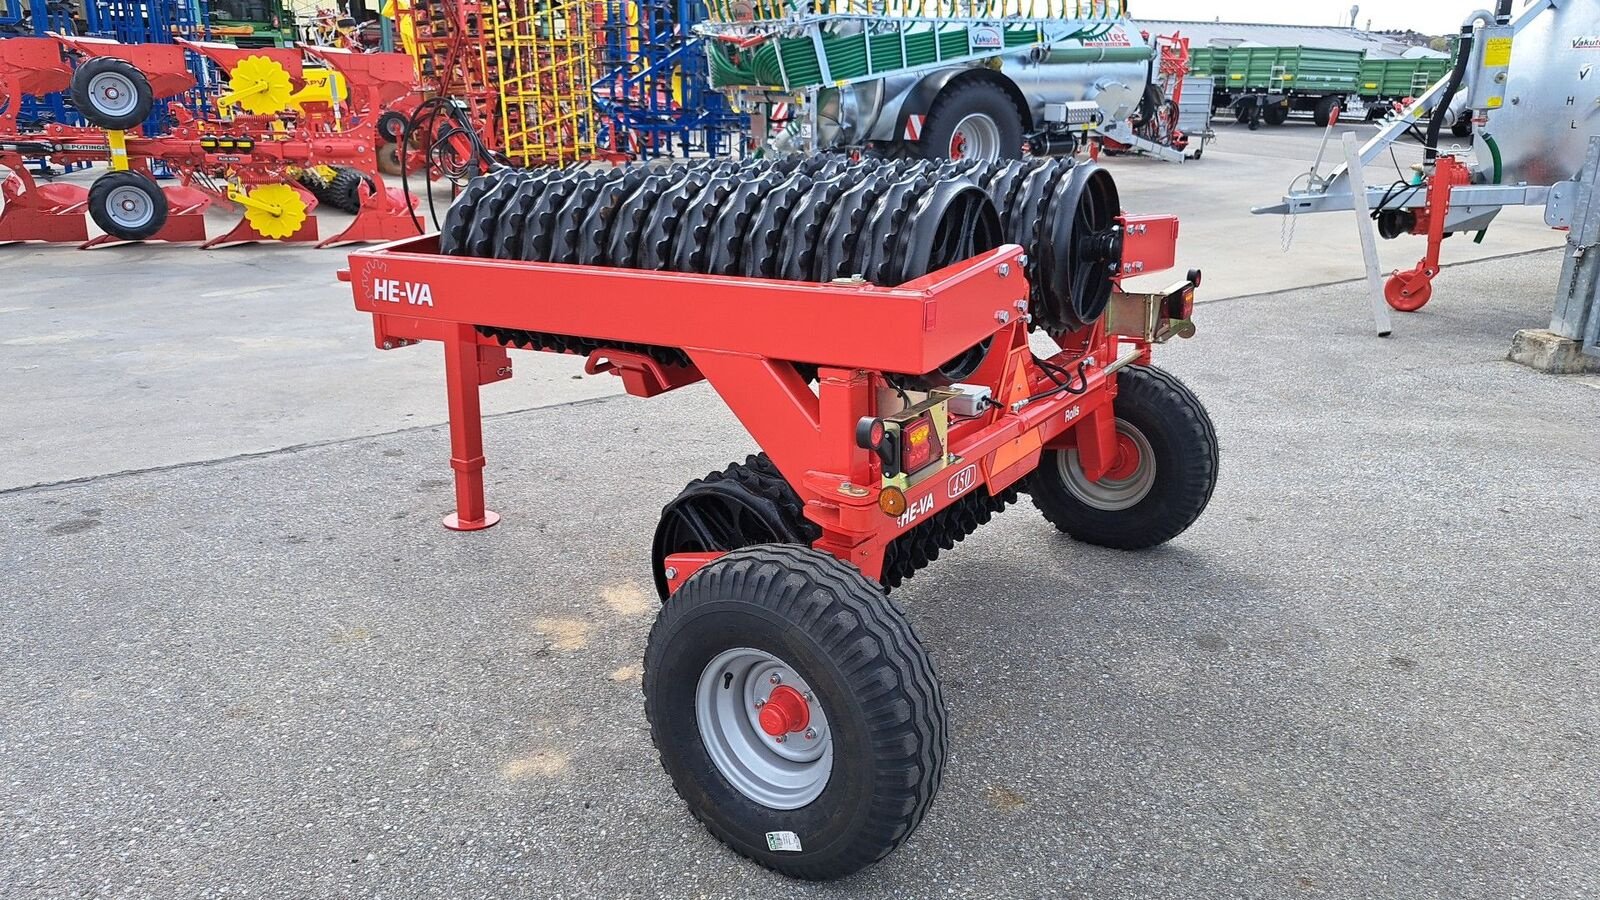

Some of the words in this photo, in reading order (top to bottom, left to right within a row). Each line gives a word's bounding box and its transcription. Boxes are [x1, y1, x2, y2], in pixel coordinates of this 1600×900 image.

[973, 34, 1000, 44] Vakutec
[1566, 96, 1575, 106] H
[374, 278, 434, 307] HE-VA
[1065, 404, 1080, 423] Rolls
[952, 468, 971, 494] 450
[901, 492, 934, 527] HE-VA
